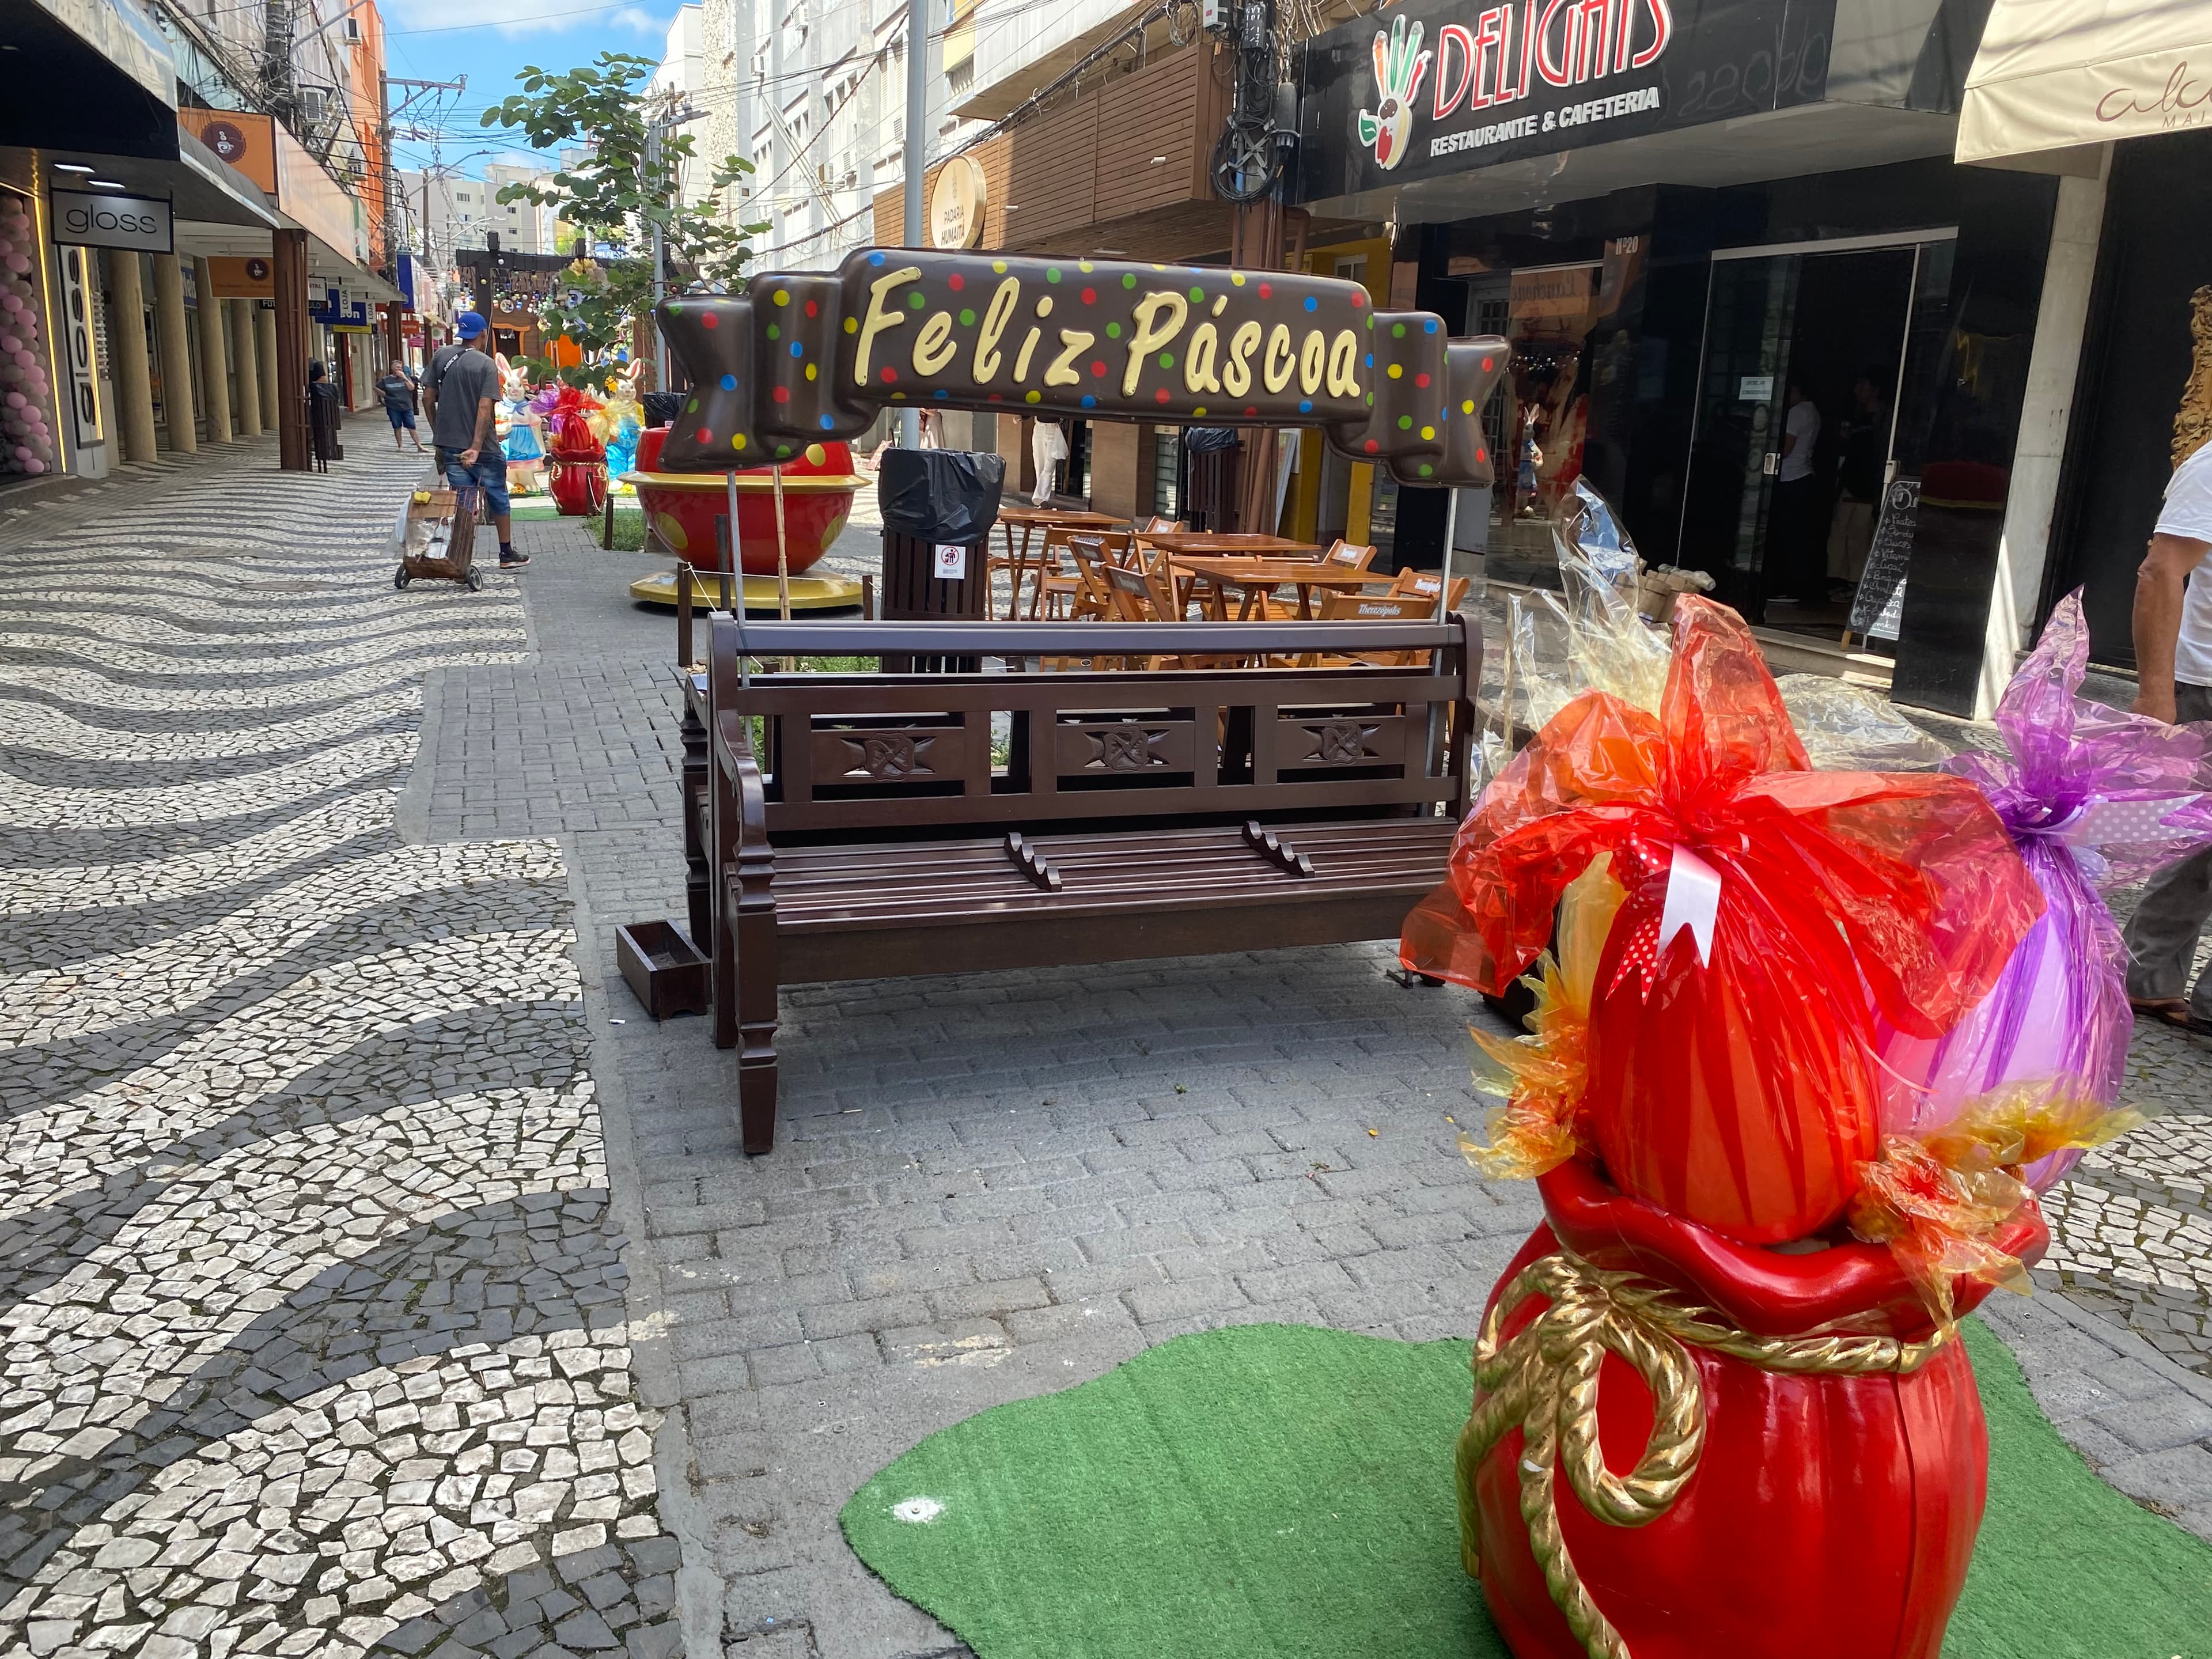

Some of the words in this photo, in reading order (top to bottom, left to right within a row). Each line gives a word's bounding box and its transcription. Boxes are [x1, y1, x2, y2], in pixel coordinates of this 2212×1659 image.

[1430, 115, 1538, 157] RESTAURANTE
[1541, 111, 1557, 132] &
[1559, 86, 1660, 128] CAFETERIA
[65, 204, 157, 234] gloss
[944, 204, 964, 225] PADARIA
[941, 219, 965, 245] HUMAITÁ
[854, 266, 1095, 387] Feliz
[1122, 291, 1361, 397] Páscoa
[444, 354, 459, 372] NIKE
